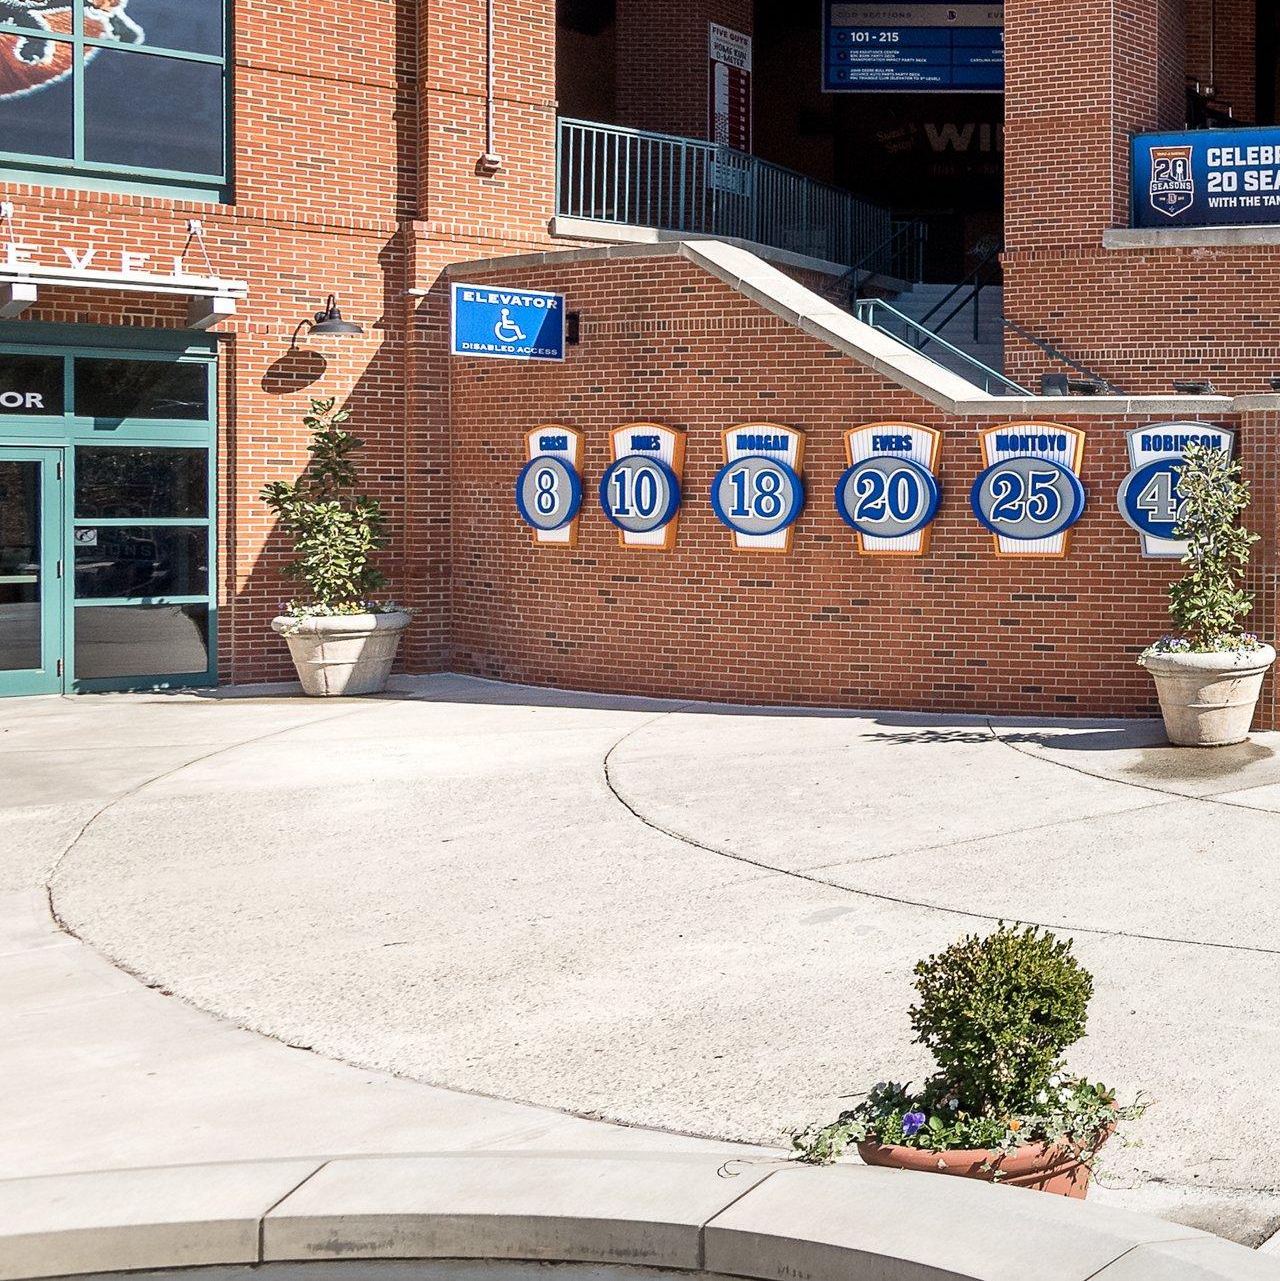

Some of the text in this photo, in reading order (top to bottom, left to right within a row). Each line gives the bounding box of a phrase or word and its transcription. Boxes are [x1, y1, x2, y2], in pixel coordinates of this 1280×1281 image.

[850, 32, 869, 42] 101
[879, 32, 899, 42] 215
[1152, 182, 1191, 191] SEASONS
[1207, 171, 1237, 192] 20
[1208, 197, 1238, 208] WITH
[1239, 196, 1260, 207] THE
[462, 291, 558, 310] ELEVATOR
[462, 342, 558, 356] DISABLED ACCESS
[0, 391, 45, 408] OR
[736, 435, 789, 451] MORGAN
[872, 435, 913, 451] EVERS
[1141, 434, 1222, 452] ROBINSON
[534, 468, 560, 517] 8
[611, 466, 659, 518] 10
[729, 466, 786, 520] 18
[853, 467, 922, 523] 20
[989, 468, 1061, 524] 25
